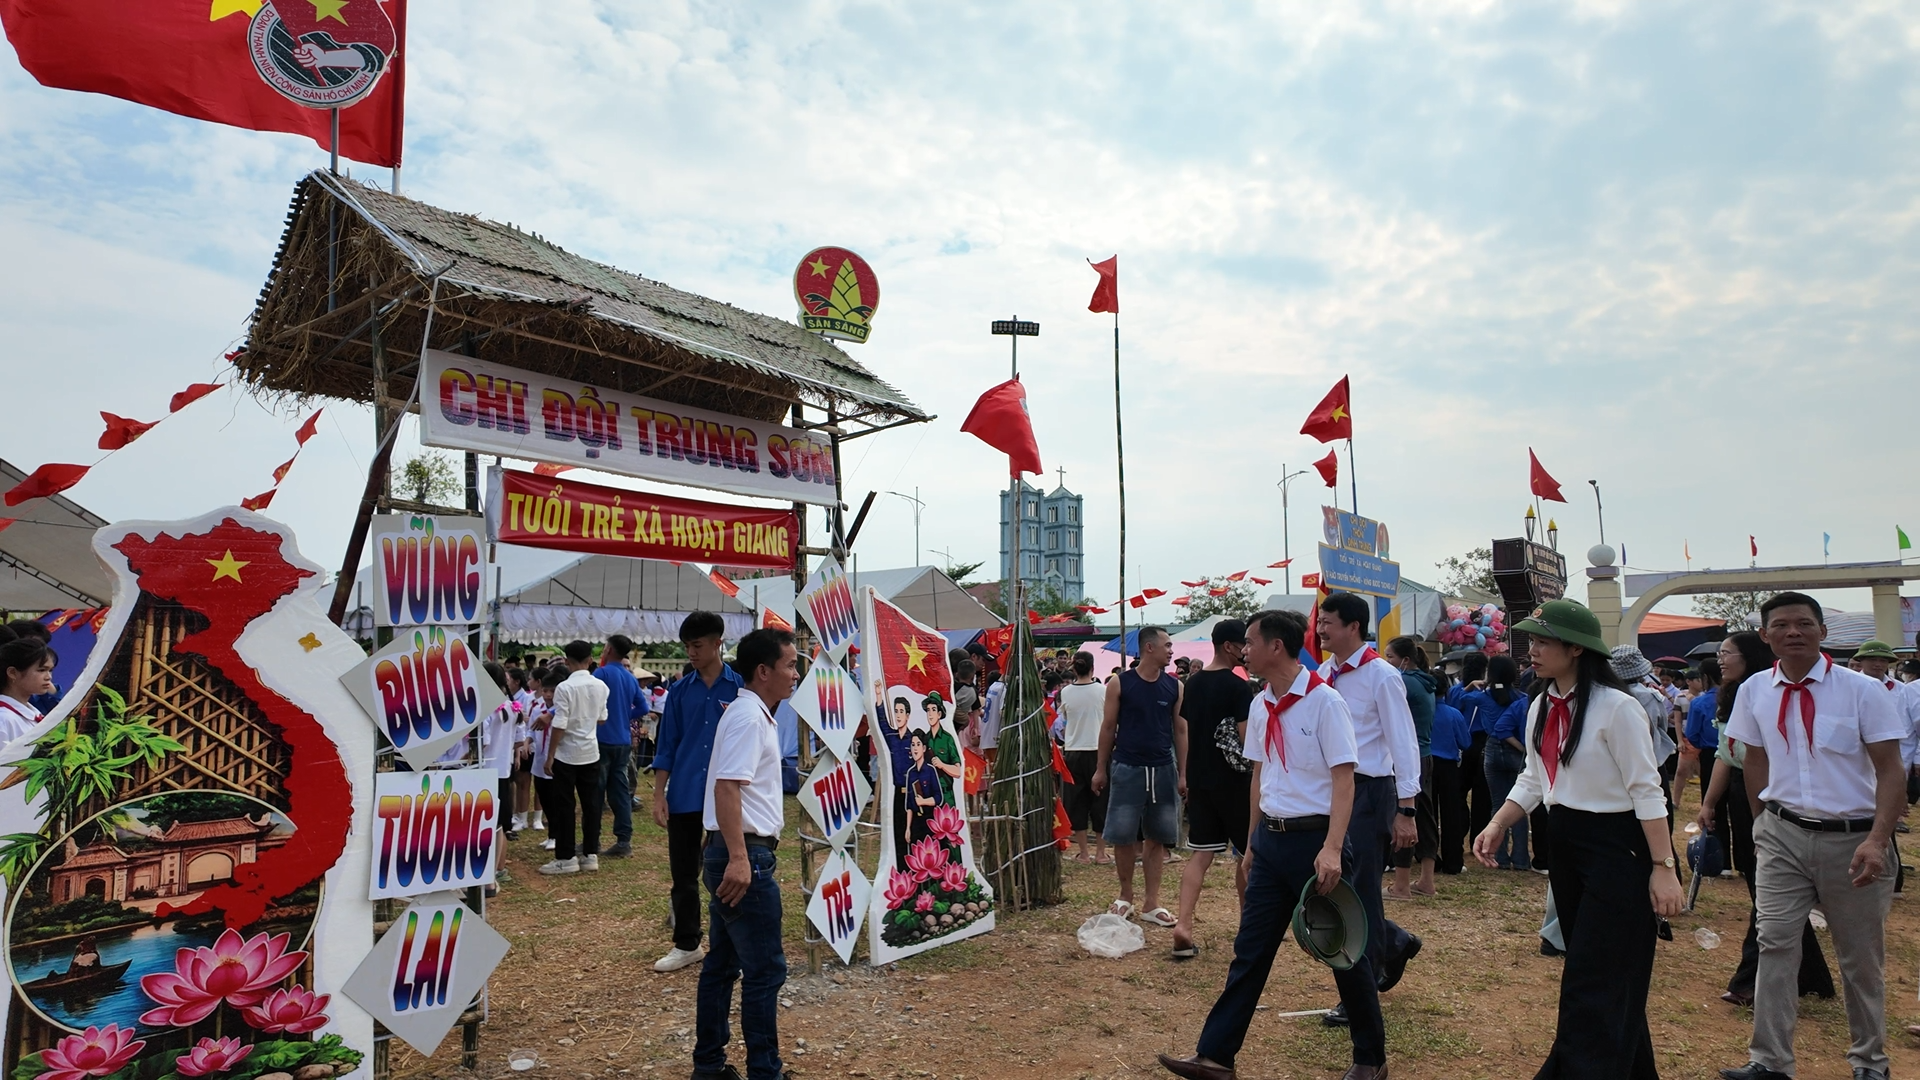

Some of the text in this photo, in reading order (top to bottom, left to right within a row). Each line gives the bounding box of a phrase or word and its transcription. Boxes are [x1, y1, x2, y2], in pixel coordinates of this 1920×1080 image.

[254, 32, 266, 58] THANH
[353, 73, 370, 92] MINH
[440, 368, 836, 486] CHI ĐỘI TRUNG SƠN
[507, 484, 789, 558] TUỔI TRẺ XÃ HOẠT GIANG
[382, 517, 480, 625] VỮNG
[807, 567, 859, 652] VƯƠN
[376, 625, 477, 748] BƯỚC
[815, 668, 845, 731] VAI
[378, 774, 492, 889] TƯƠNG
[822, 850, 855, 944] TRẺ
[394, 907, 463, 1012] LAI
